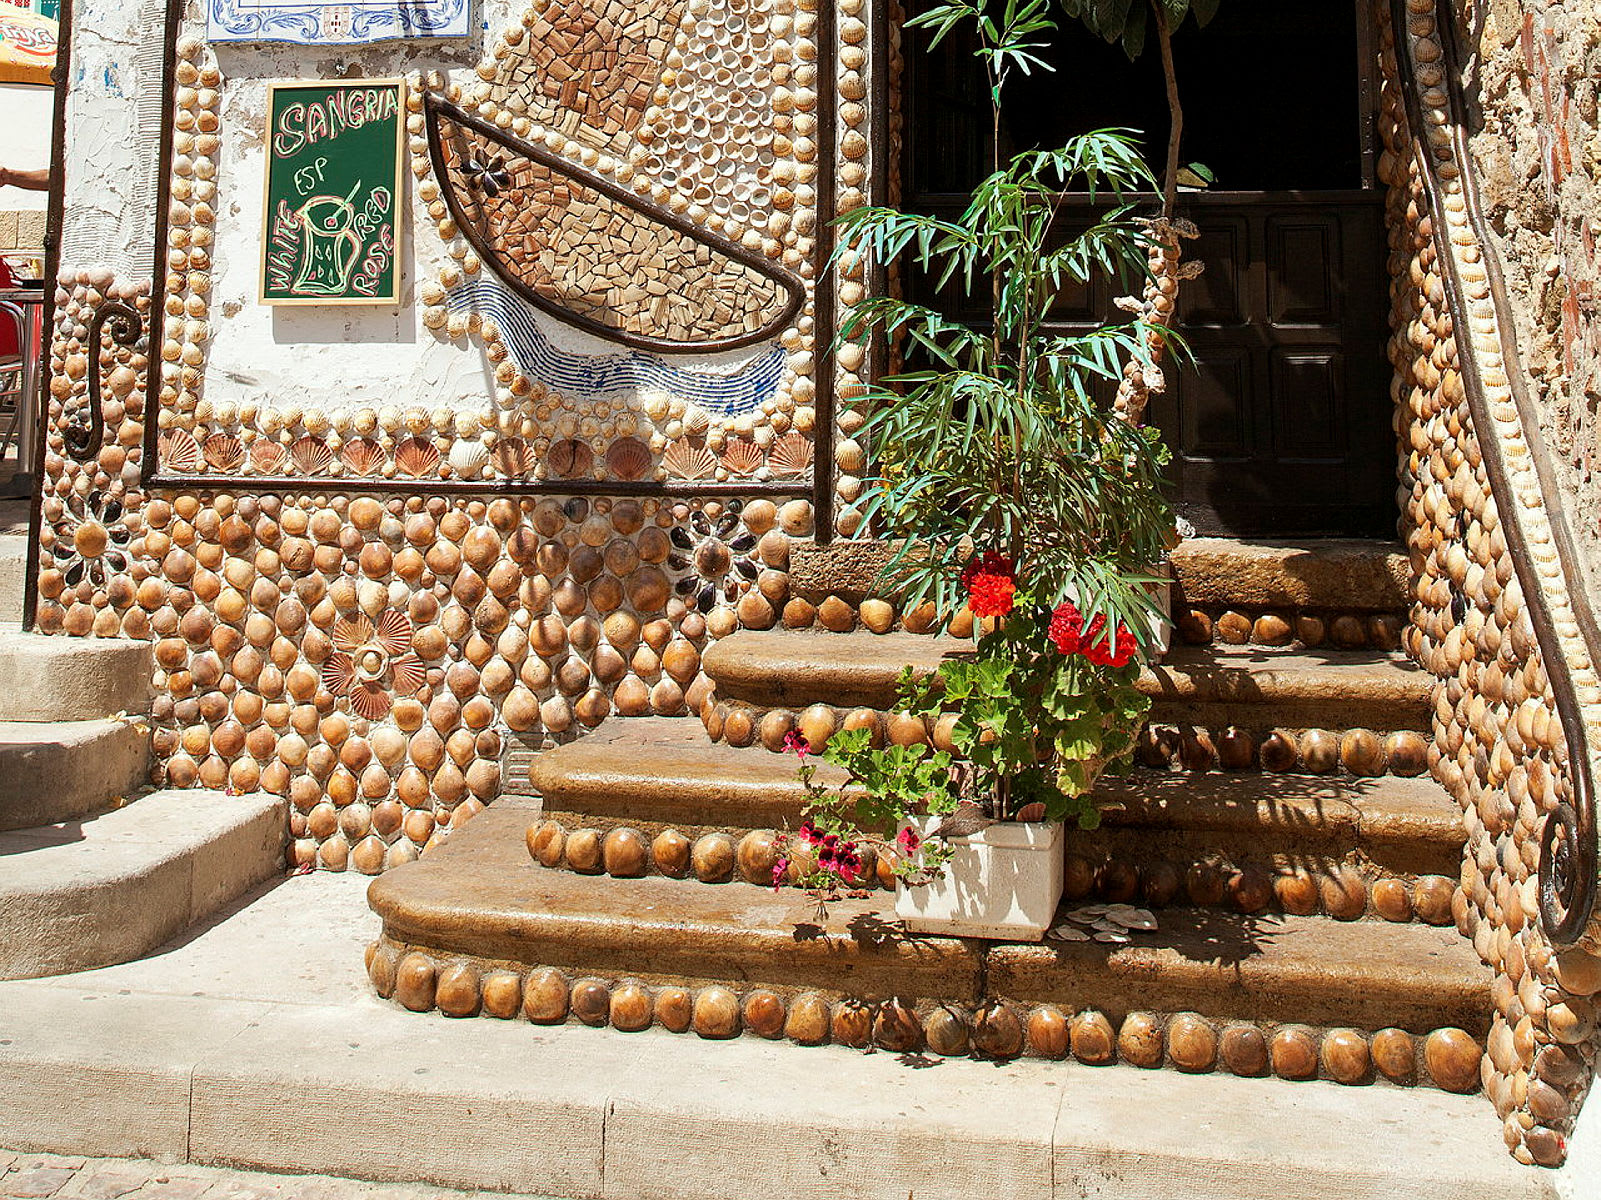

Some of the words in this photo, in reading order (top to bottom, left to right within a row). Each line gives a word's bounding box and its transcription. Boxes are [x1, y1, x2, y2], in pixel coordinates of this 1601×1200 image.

[274, 87, 400, 160] SANGRIA
[293, 156, 329, 197] ESP
[353, 186, 391, 242] RED
[352, 223, 395, 297] ROSE
